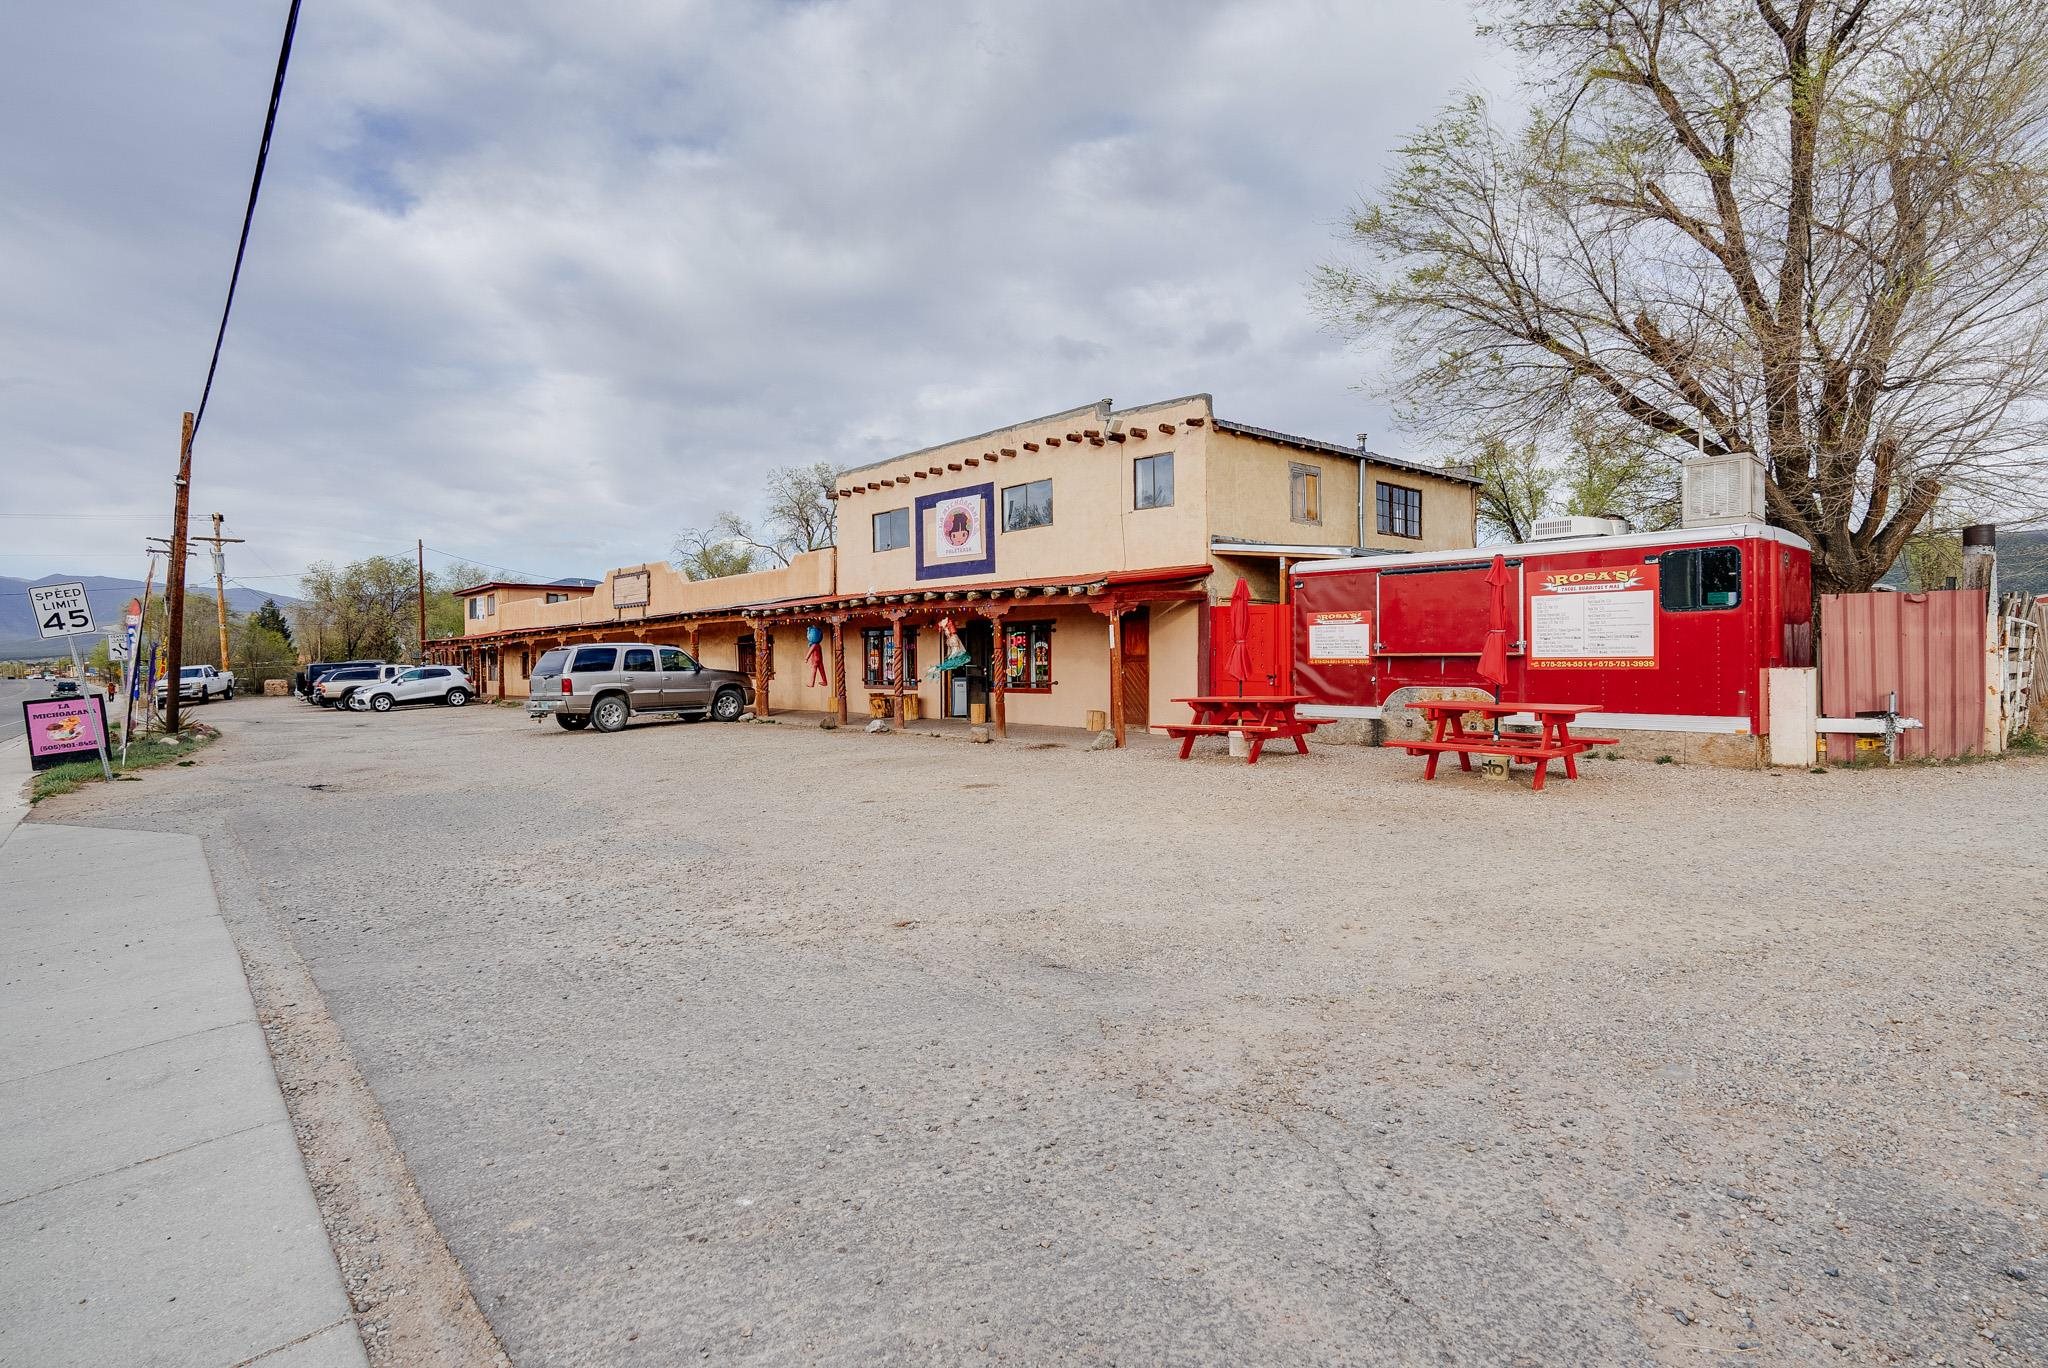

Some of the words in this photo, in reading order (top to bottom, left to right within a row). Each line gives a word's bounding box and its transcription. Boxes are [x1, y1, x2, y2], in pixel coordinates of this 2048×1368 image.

[1553, 571, 1629, 586] ROSA'S
[35, 588, 81, 601] SPEED
[43, 599, 77, 611] LIMIT
[43, 609, 89, 630] 45
